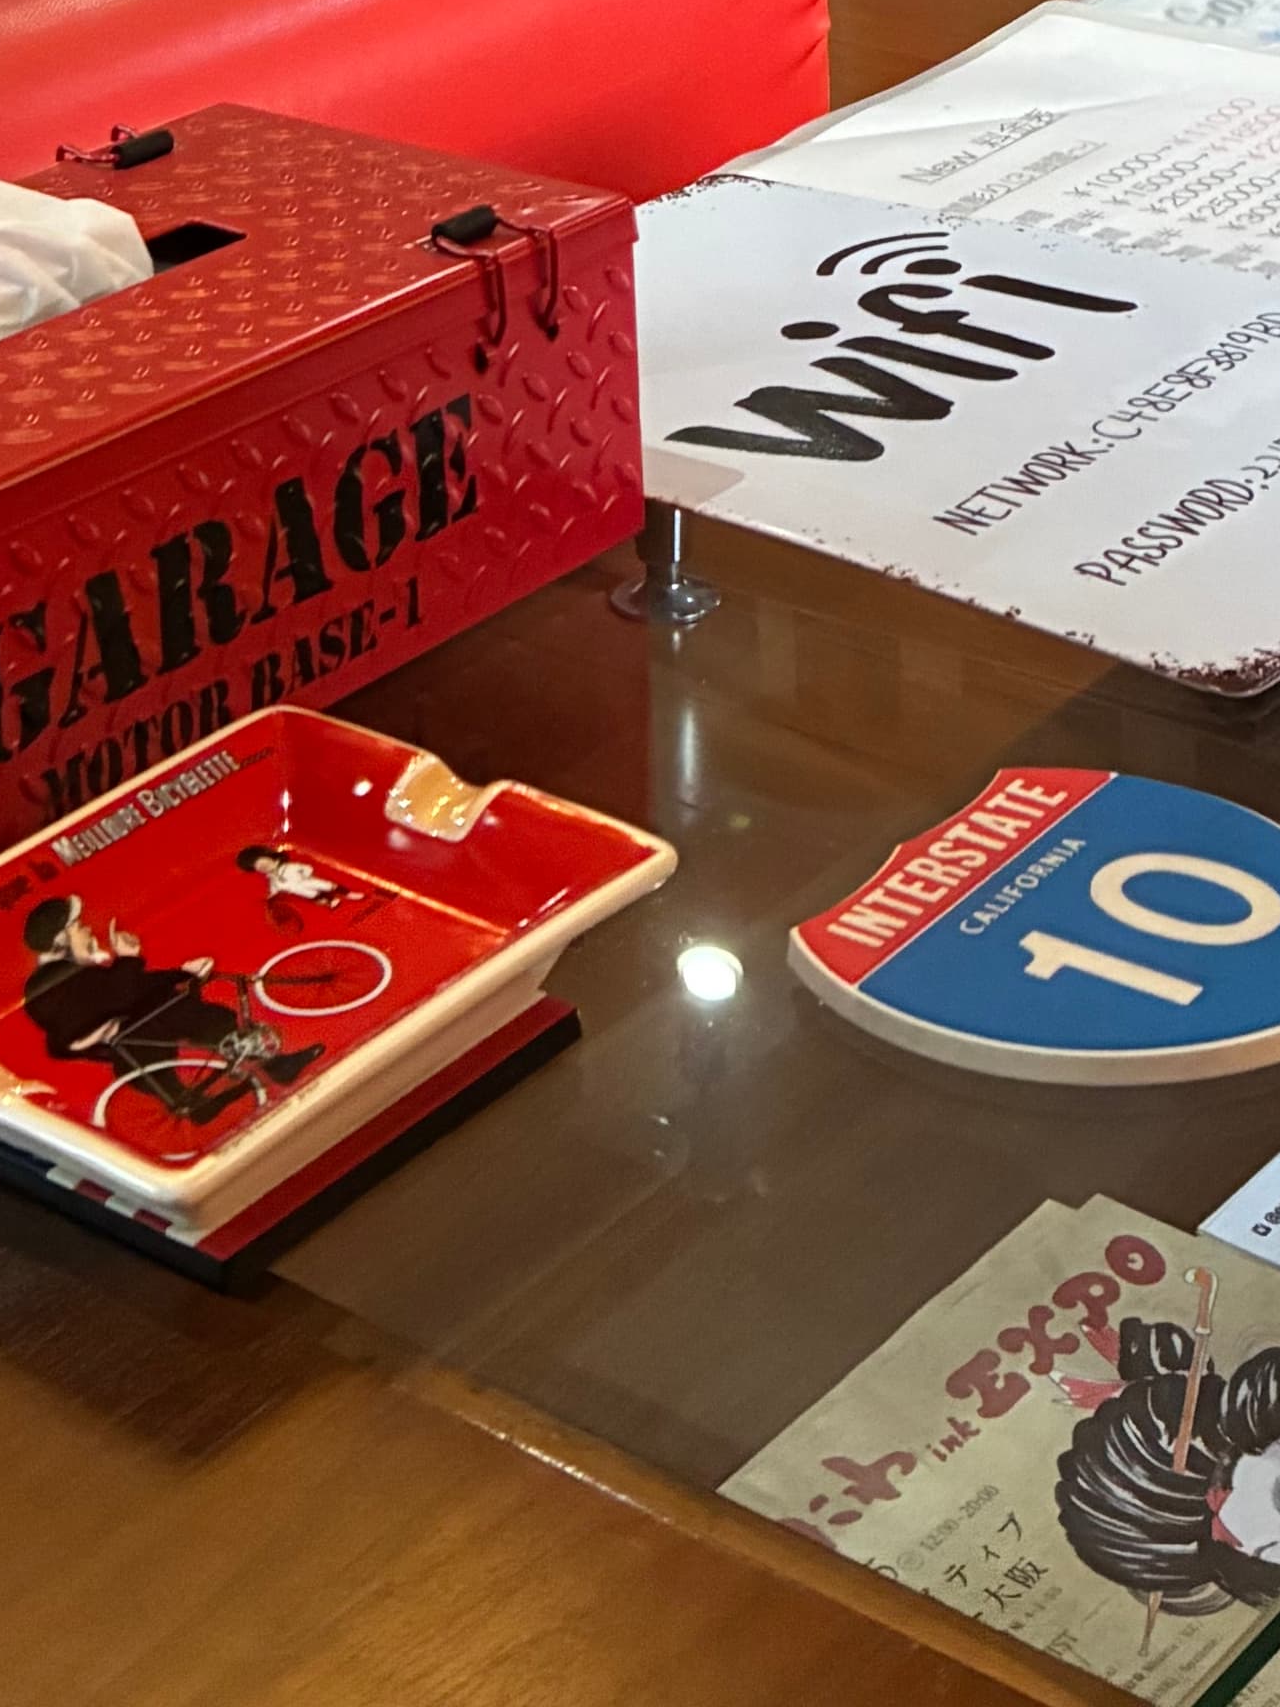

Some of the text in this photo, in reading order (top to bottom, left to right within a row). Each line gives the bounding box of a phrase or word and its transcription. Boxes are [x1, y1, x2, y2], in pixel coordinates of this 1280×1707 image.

[901, 150, 978, 186] New
[1066, 152, 1161, 197] ¥10000
[1104, 161, 1197, 205] ¥15000
[1140, 168, 1235, 215] ¥20000
[1178, 177, 1273, 223] ¥25000
[664, 255, 1139, 462] wifi
[40, 577, 425, 819] MOTOR BASE-1
[826, 777, 1068, 949] INTERSTATE
[958, 836, 1087, 936] CALIFORNIA
[925, 1234, 1167, 1464] ink EXPO
